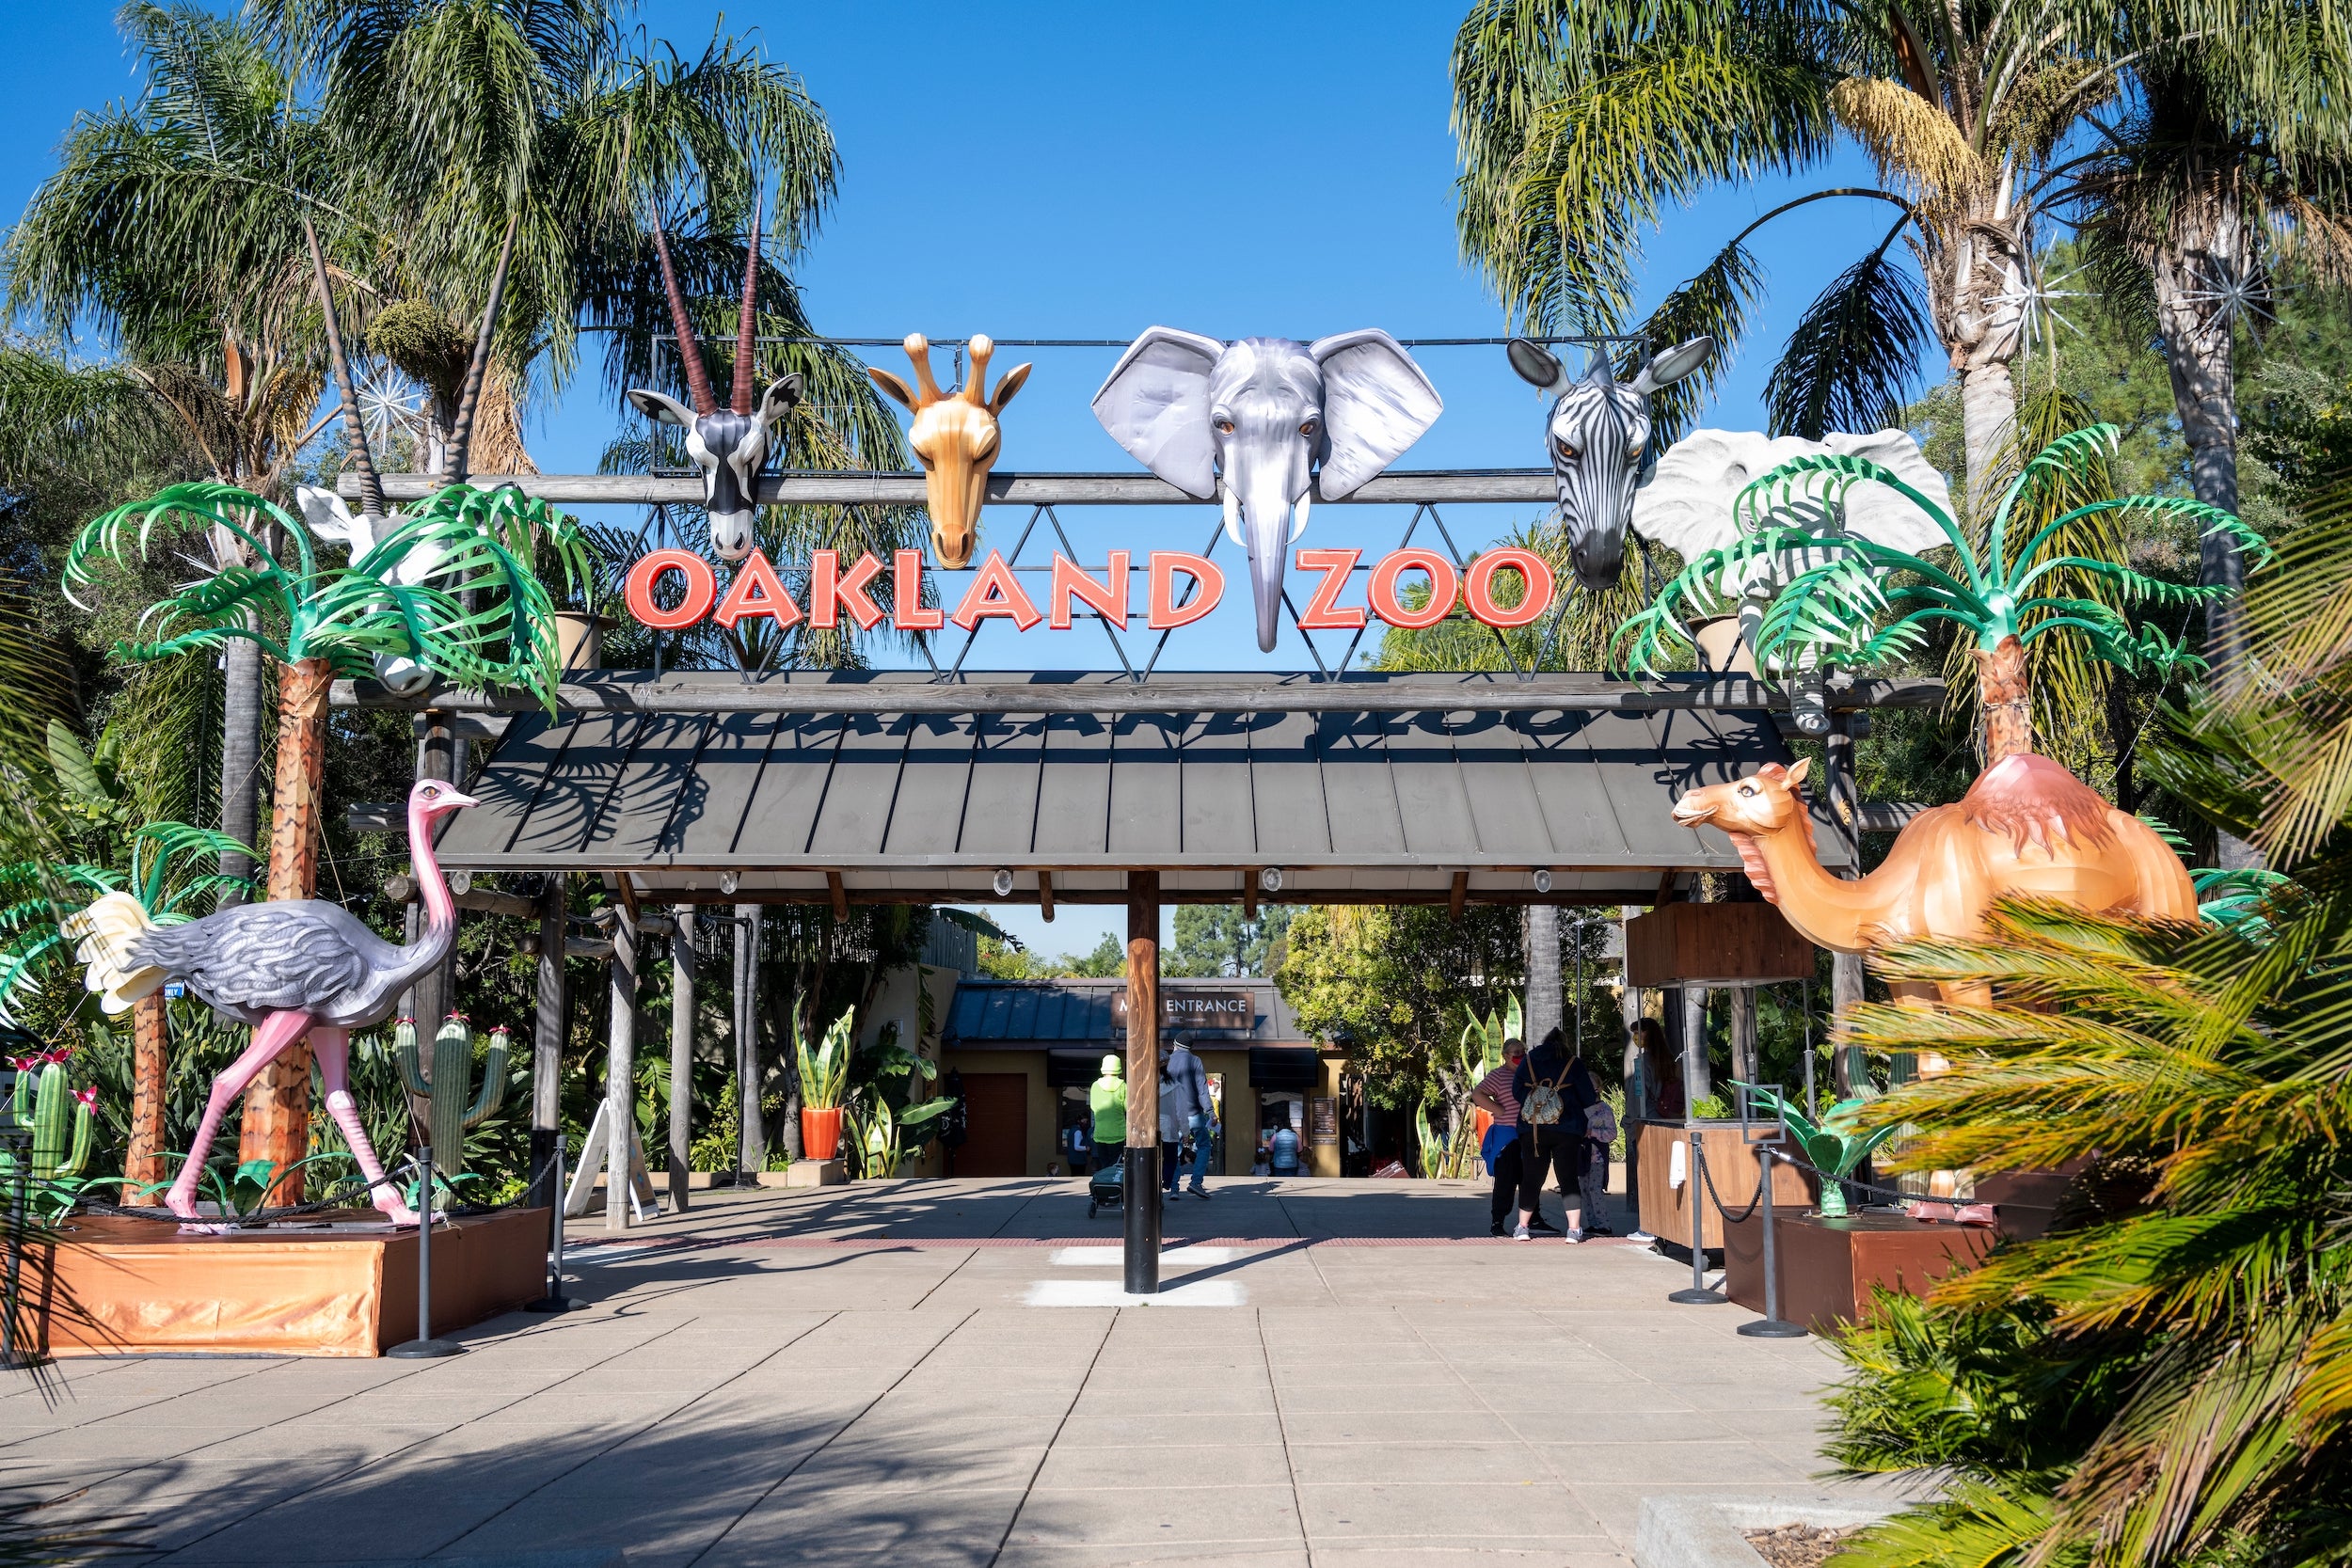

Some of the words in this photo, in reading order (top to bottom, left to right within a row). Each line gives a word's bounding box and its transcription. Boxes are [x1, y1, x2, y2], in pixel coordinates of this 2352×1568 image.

[625, 546, 1225, 631] OAKLAND
[1295, 546, 1554, 629] ZOO
[1166, 999, 1246, 1012] ENTRANCE
